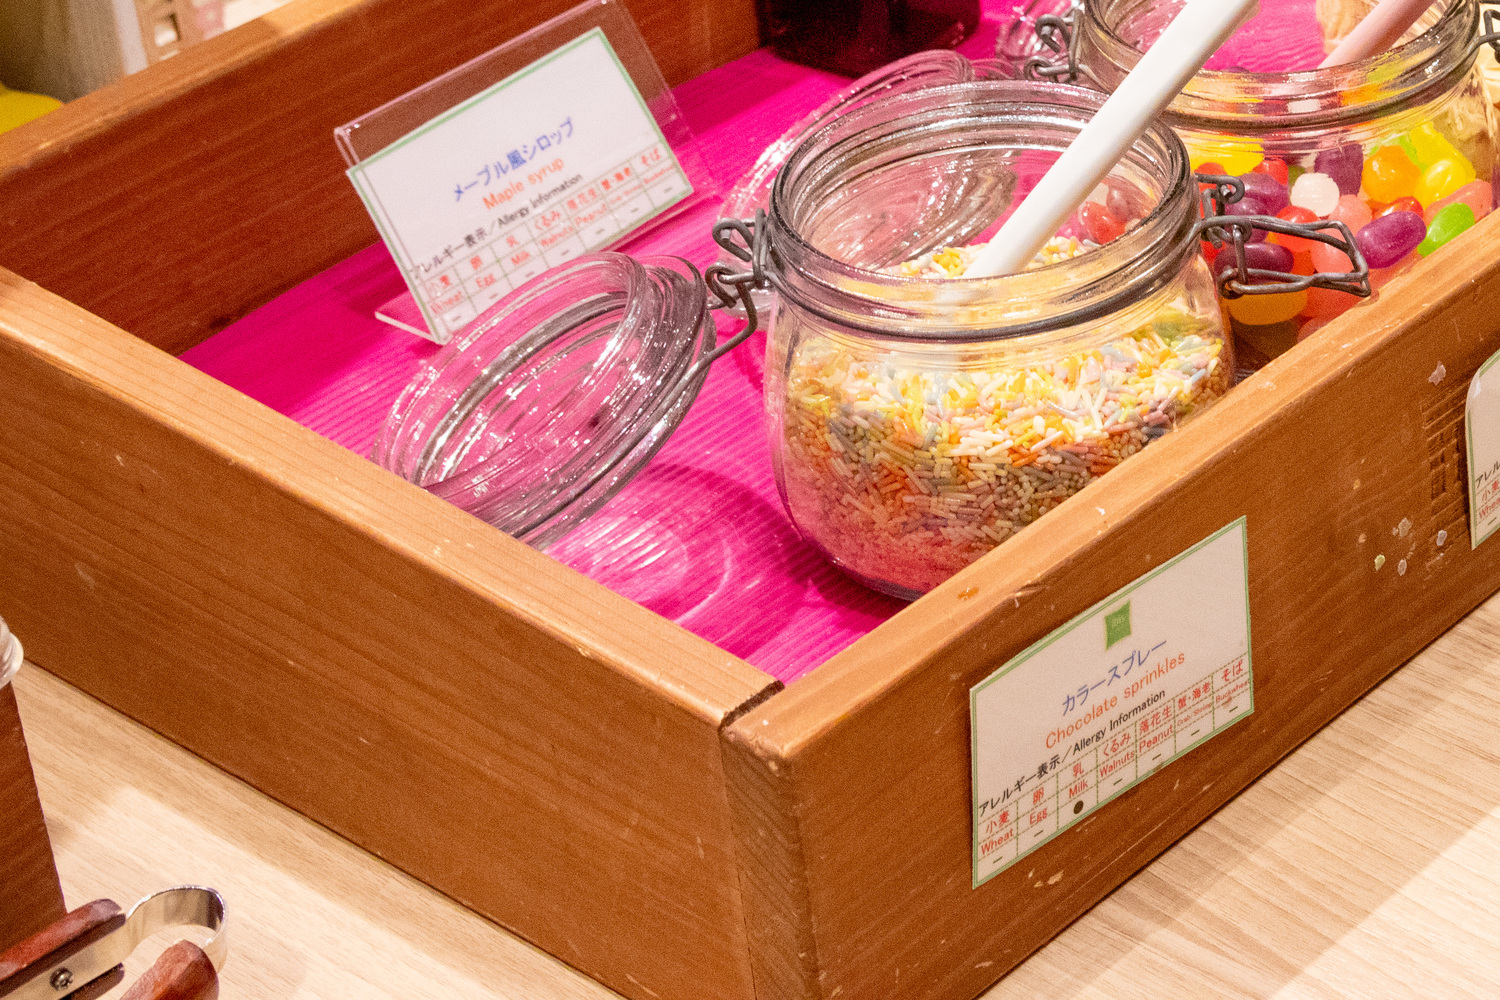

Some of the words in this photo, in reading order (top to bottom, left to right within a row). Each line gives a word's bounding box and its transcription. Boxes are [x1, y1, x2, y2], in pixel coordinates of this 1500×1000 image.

[454, 116, 573, 201] メープル風シロップ
[482, 181, 523, 209] Maple
[527, 158, 564, 184] syrup
[530, 174, 582, 208] Information
[475, 273, 496, 289] Egg
[510, 251, 530, 265] Milk
[1482, 480, 1499, 499] 小麦
[1045, 696, 1117, 748] Chocolate
[1123, 652, 1184, 698] sprinkles
[1062, 640, 1166, 715] カラースプレー
[1109, 689, 1165, 730] Information
[986, 810, 1008, 831] 小麦
[1032, 786, 1044, 805] 卵
[1072, 762, 1084, 777] 乳
[1103, 732, 1130, 756] くるみ
[1139, 706, 1170, 733] 落花生
[1221, 659, 1242, 681] そば
[981, 828, 1013, 854] Wheat
[1029, 807, 1047, 827] Egg
[1068, 780, 1087, 798] Milk
[1099, 751, 1134, 777] Walnuts
[1139, 725, 1173, 752] Peanut
